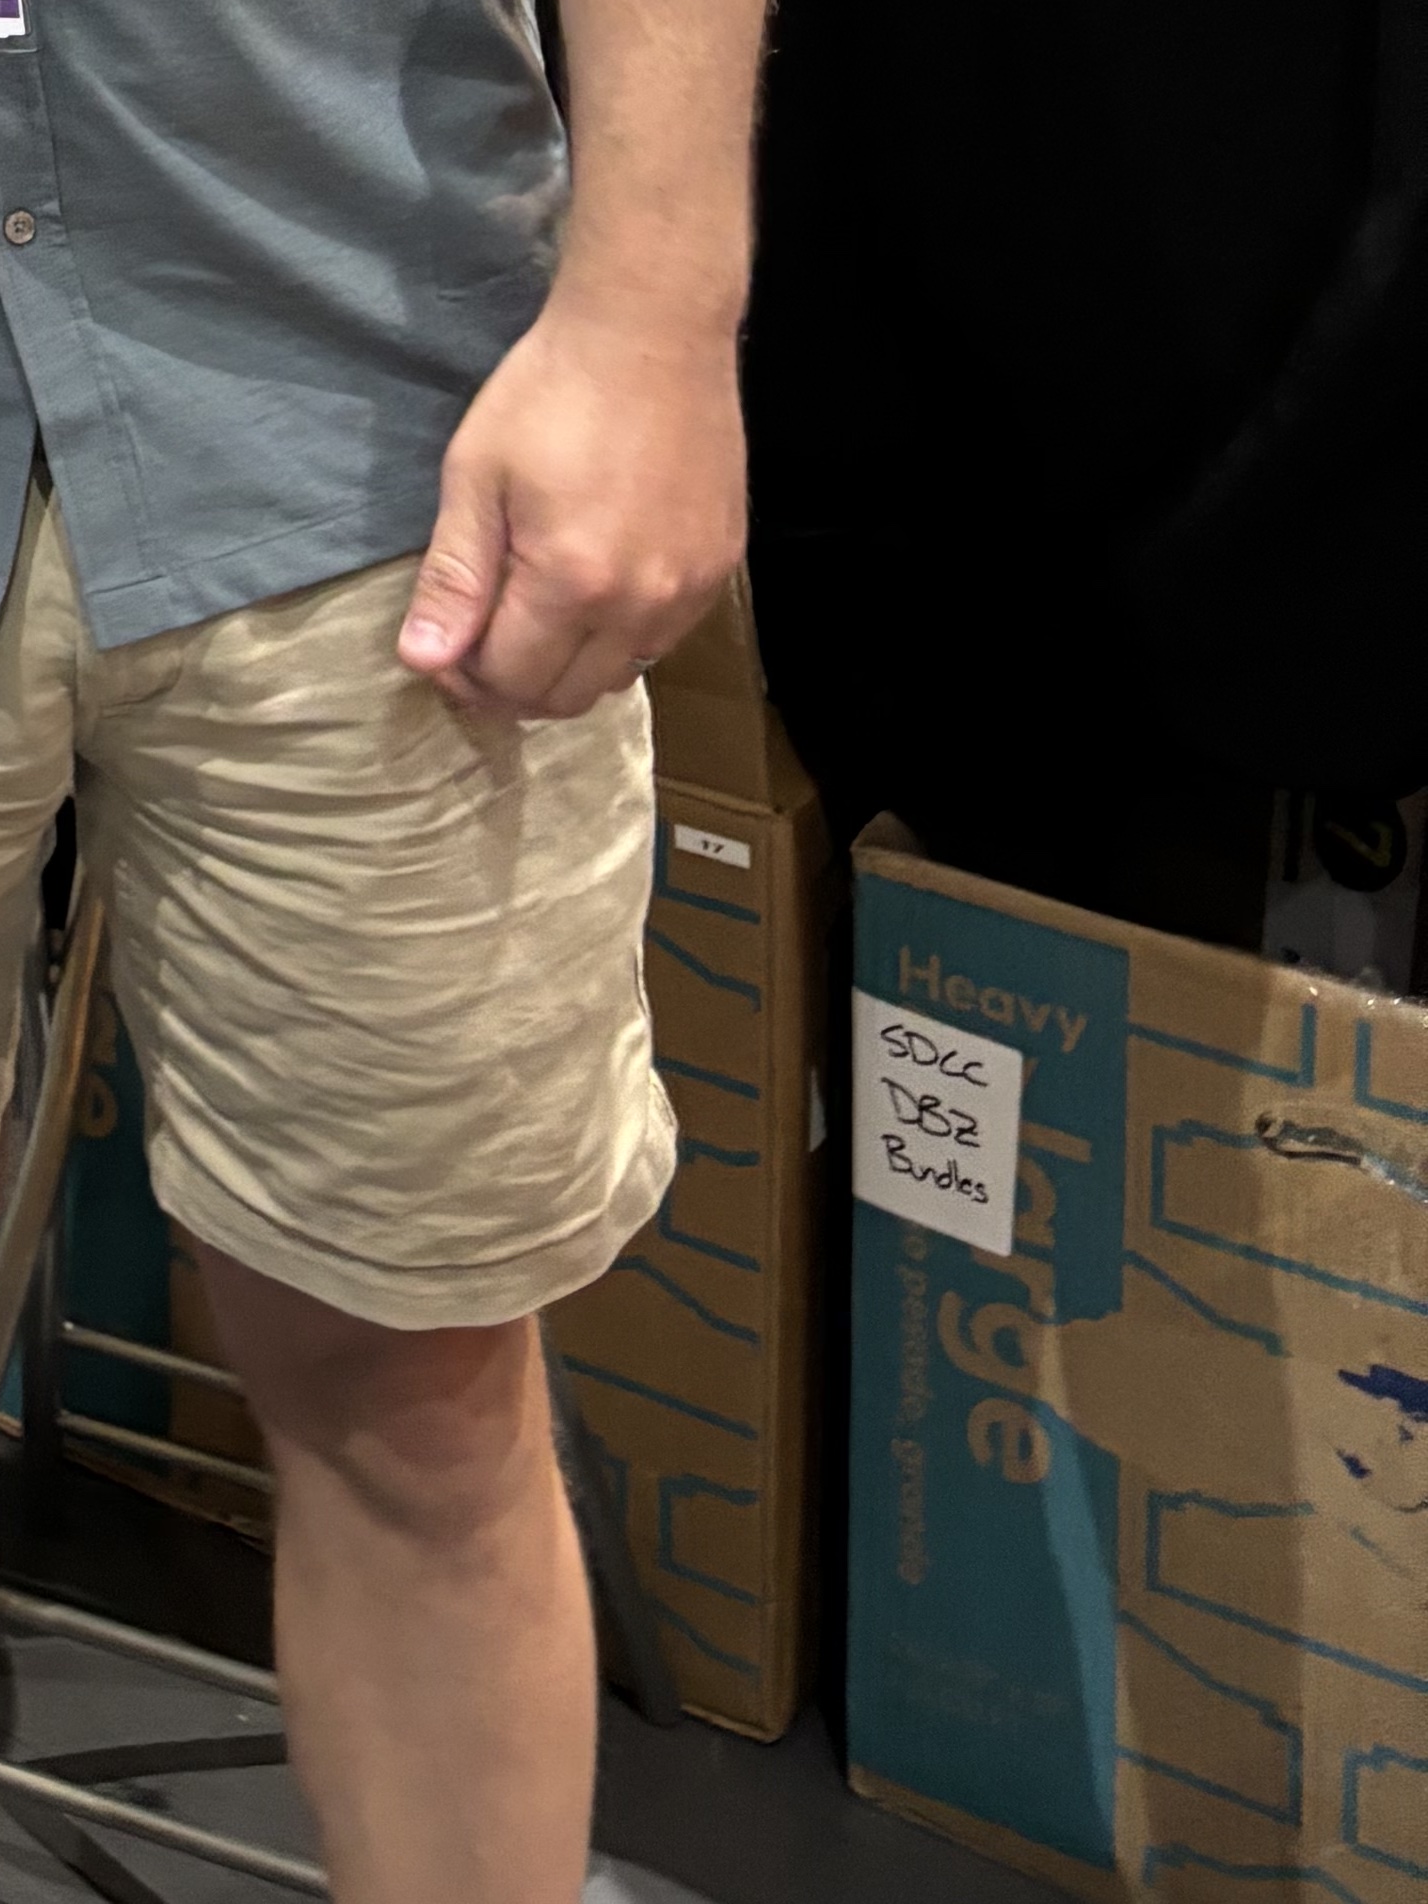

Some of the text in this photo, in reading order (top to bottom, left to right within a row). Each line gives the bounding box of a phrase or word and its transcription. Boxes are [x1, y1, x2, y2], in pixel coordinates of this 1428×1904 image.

[897, 944, 1091, 1054] Heavy
[880, 1024, 992, 1088] SDCC
[880, 1076, 981, 1148] DBZ
[881, 1134, 990, 1205] Bundles
